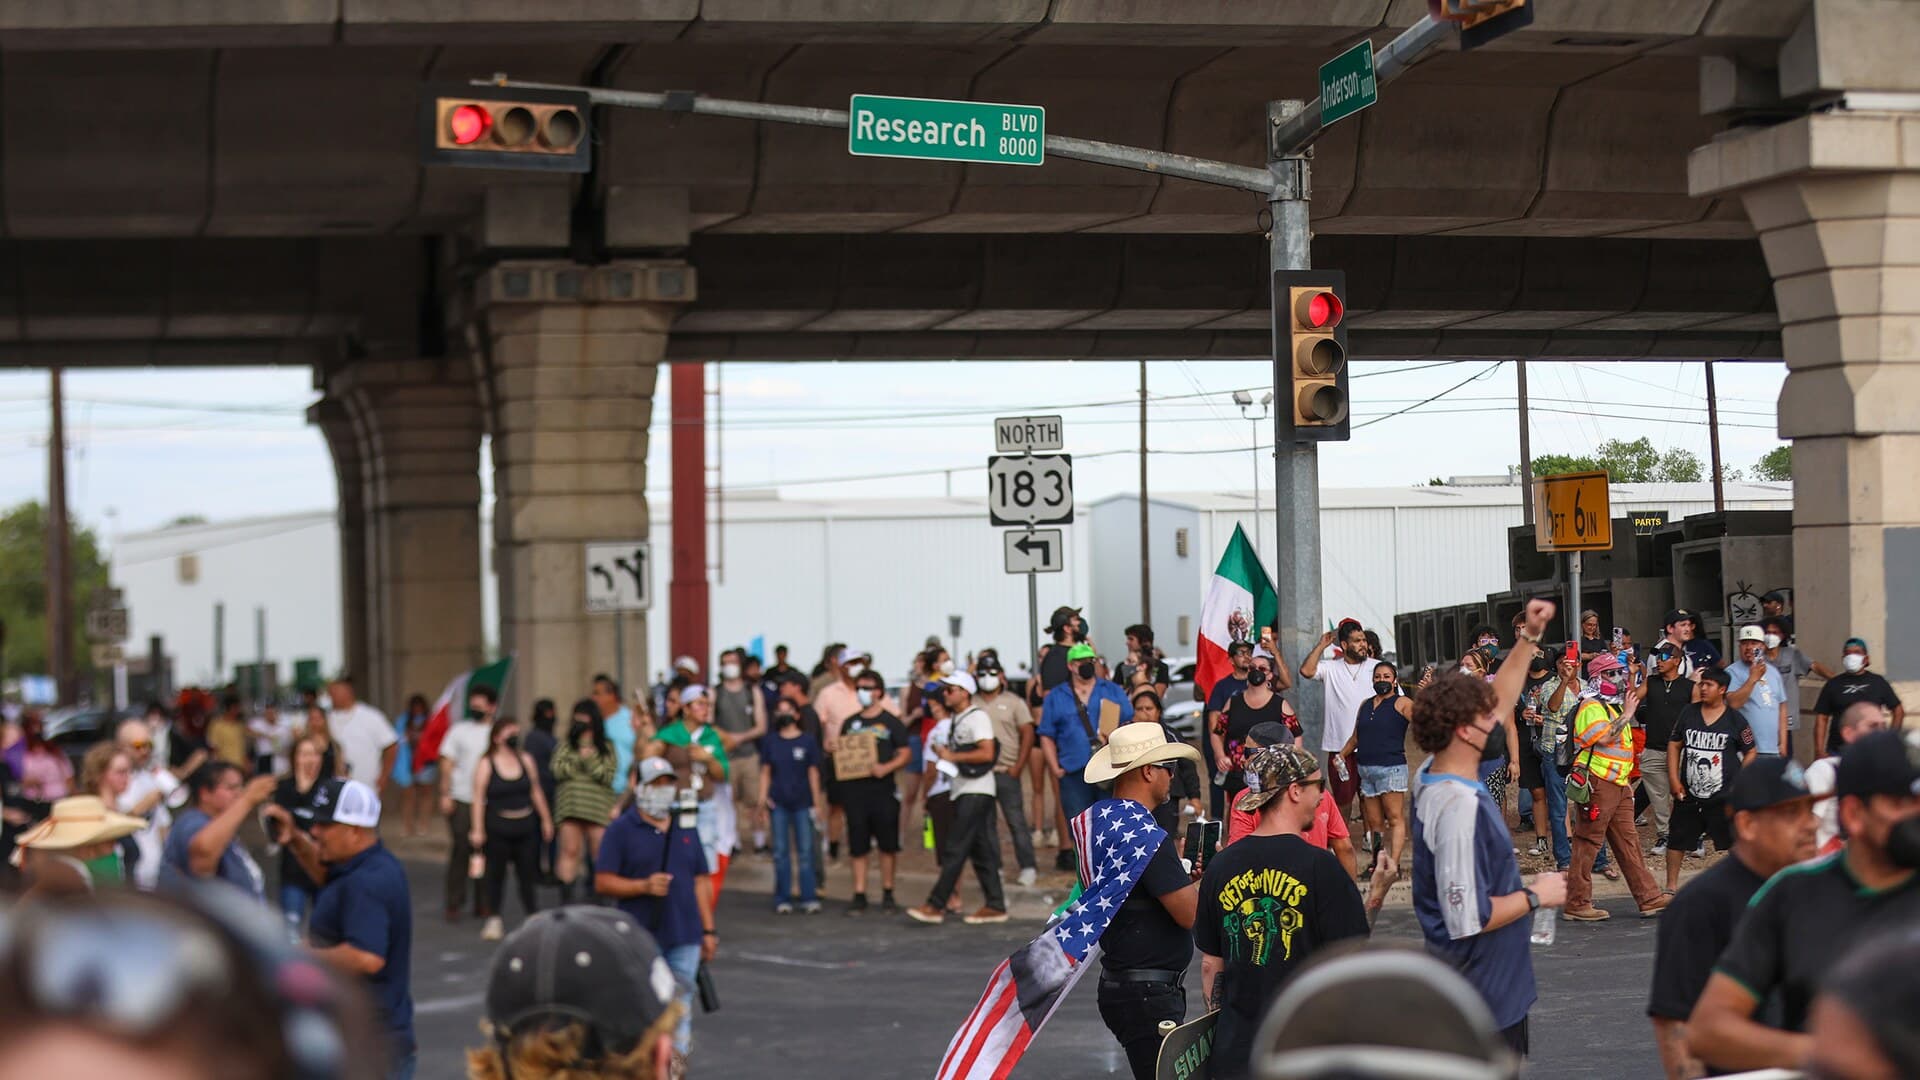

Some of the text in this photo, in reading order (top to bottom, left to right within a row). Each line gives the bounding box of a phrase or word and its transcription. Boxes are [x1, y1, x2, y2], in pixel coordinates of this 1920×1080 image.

[1322, 71, 1360, 111] Anderson
[856, 110, 986, 147] Research
[1002, 113, 1037, 132] BLVD
[999, 137, 1037, 156] 8000
[1000, 424, 1059, 444] NORTH
[997, 469, 1064, 507] 183
[1634, 518, 1662, 526] PARTS
[1685, 728, 1729, 750] SCARFACE
[1239, 869, 1254, 890] OFF
[1263, 868, 1308, 906] NUTS
